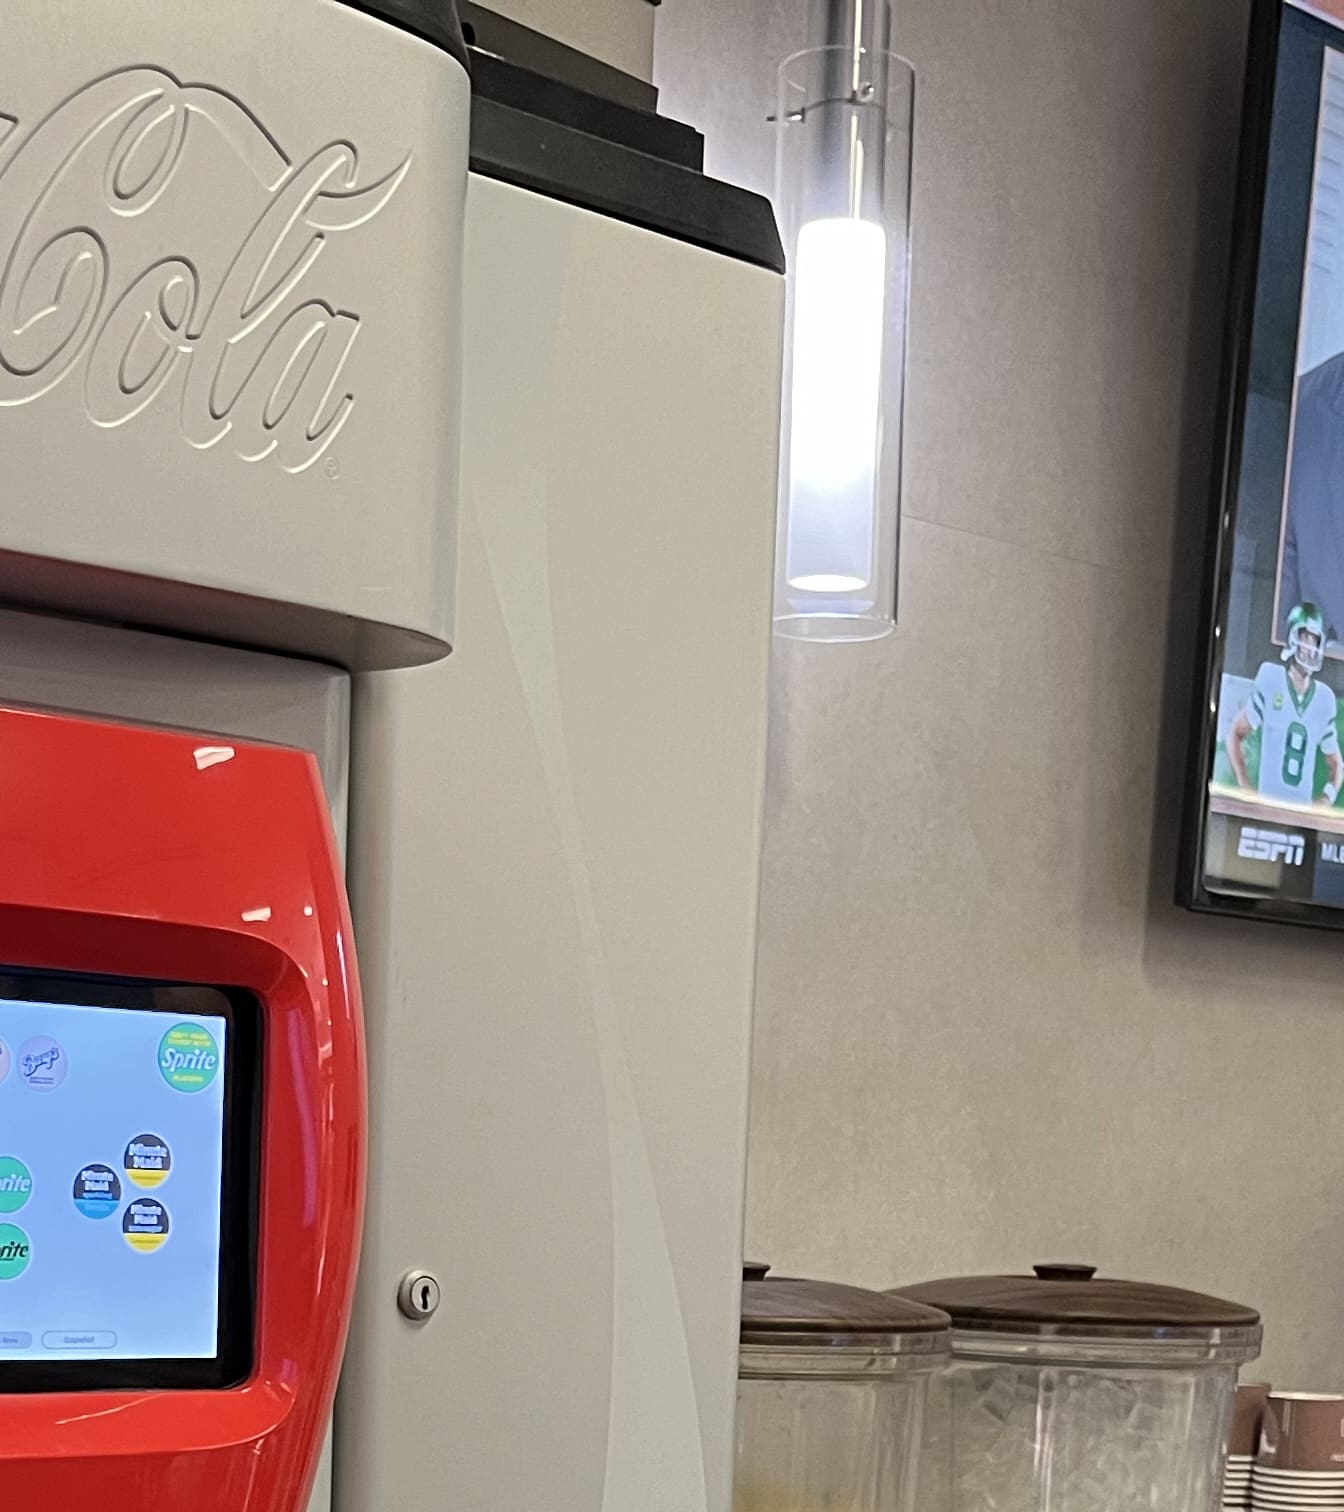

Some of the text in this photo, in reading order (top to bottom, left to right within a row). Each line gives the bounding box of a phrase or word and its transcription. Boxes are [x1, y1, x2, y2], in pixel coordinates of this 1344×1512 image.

[1281, 721, 1308, 788] 8
[1237, 826, 1306, 867] ESPN
[161, 1047, 217, 1072] Sprite
